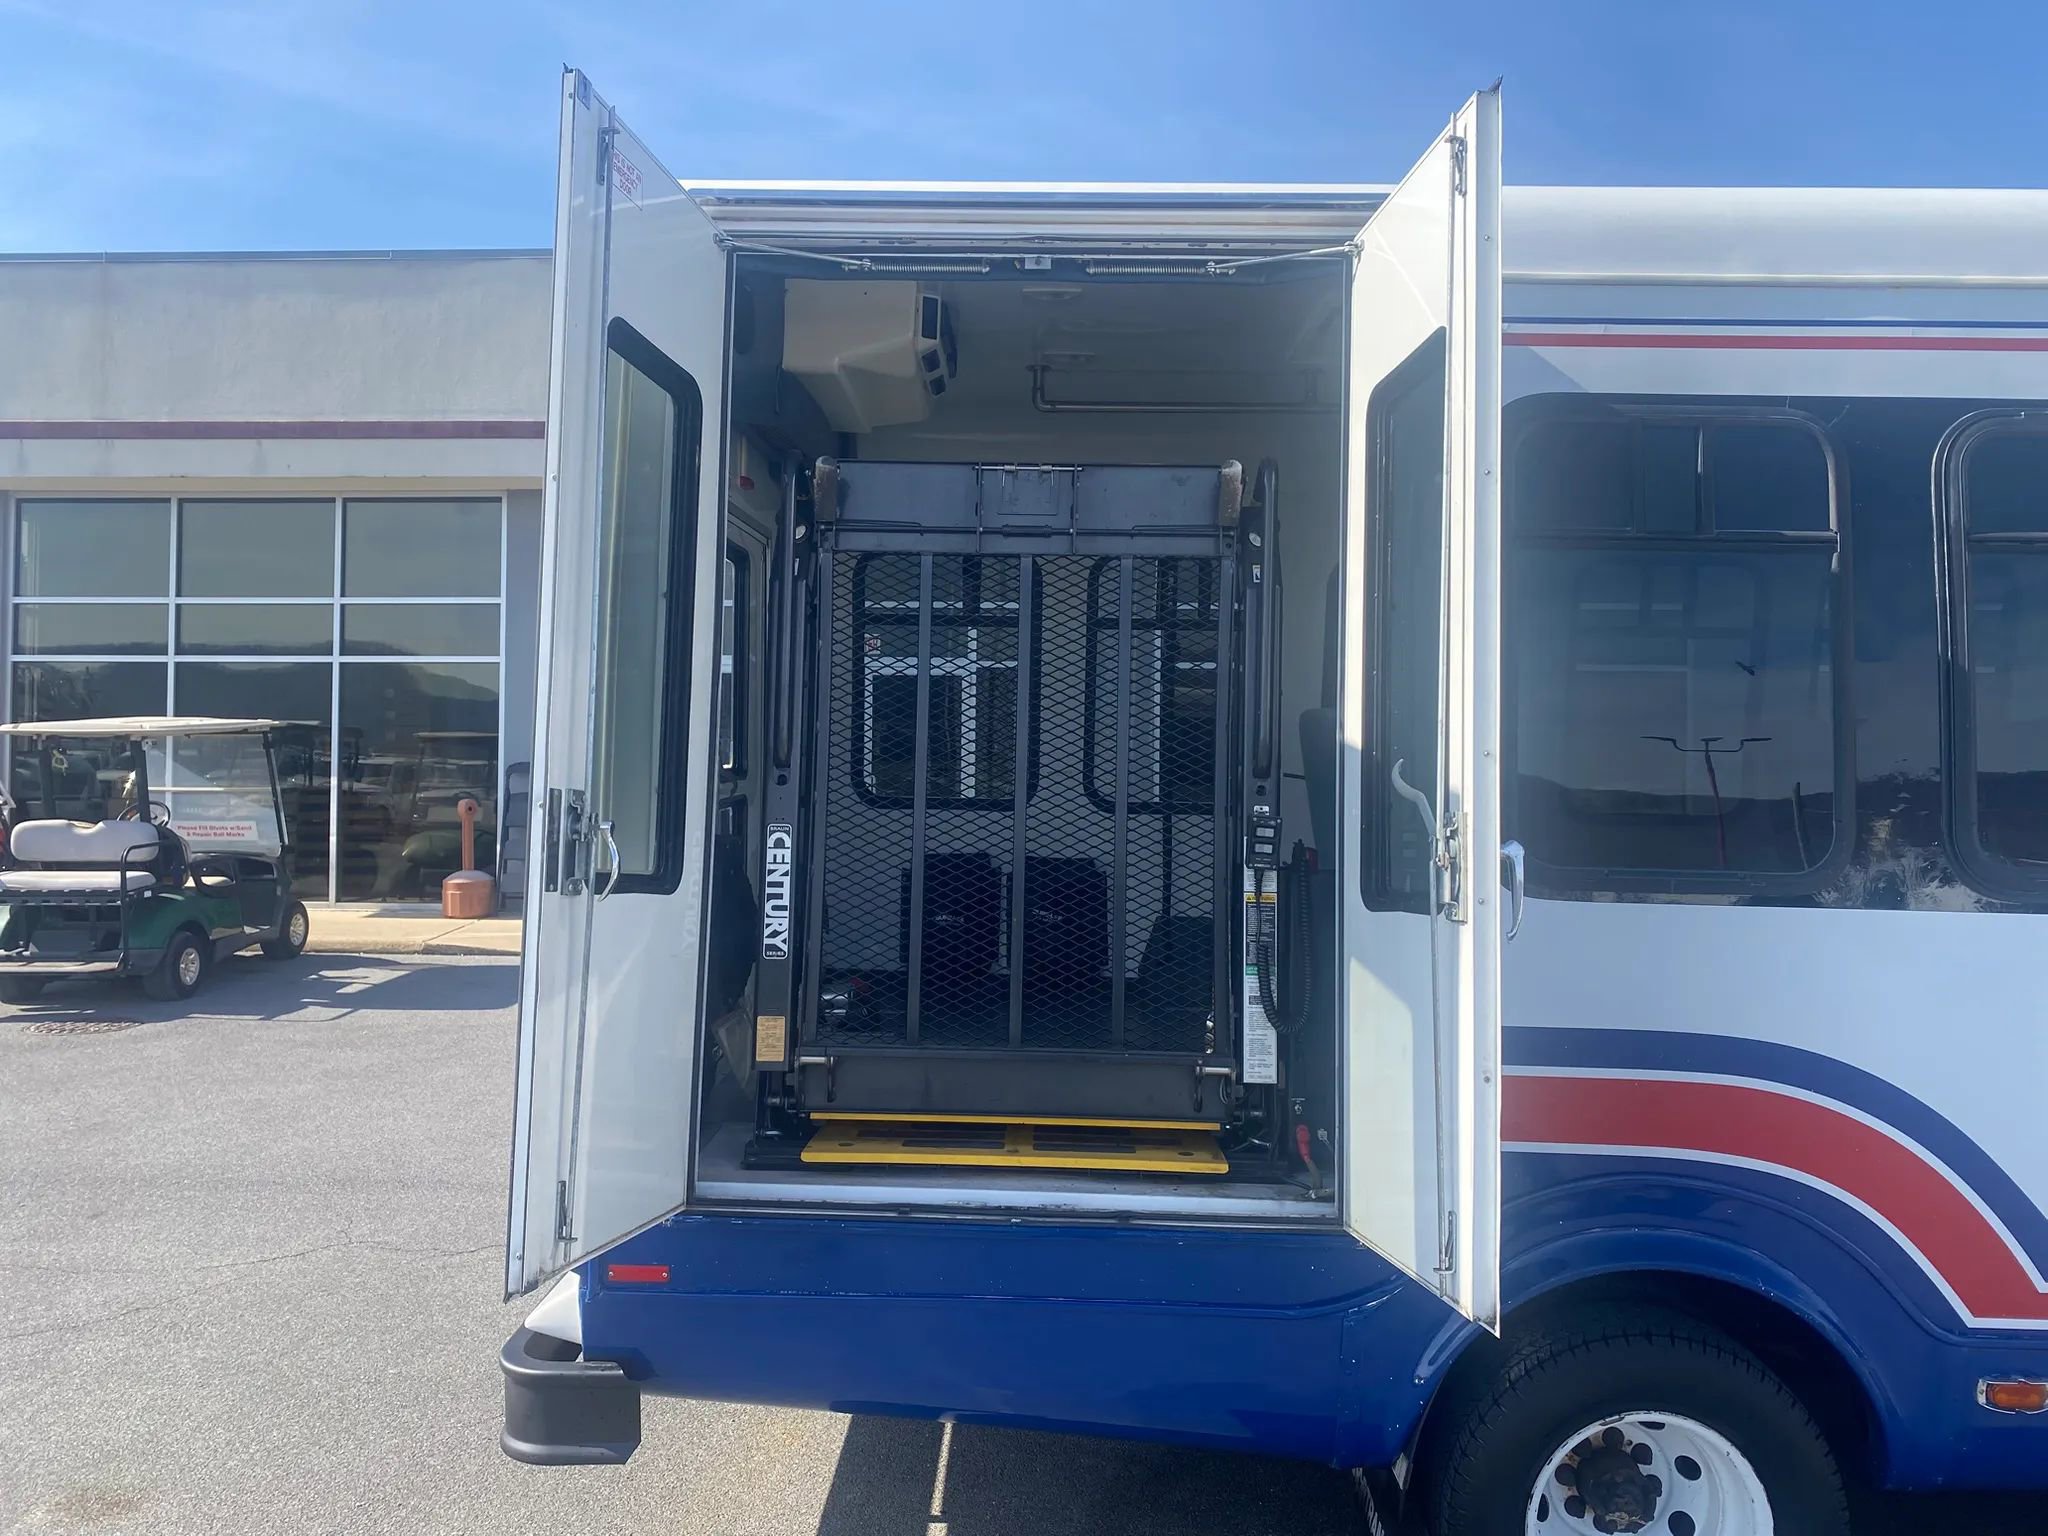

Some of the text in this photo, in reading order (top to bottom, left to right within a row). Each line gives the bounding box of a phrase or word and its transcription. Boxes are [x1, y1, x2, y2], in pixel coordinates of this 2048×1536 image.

[613, 160, 638, 193] EMERGENCY
[620, 179, 632, 197] DOOR
[764, 831, 791, 952] CENTURY
